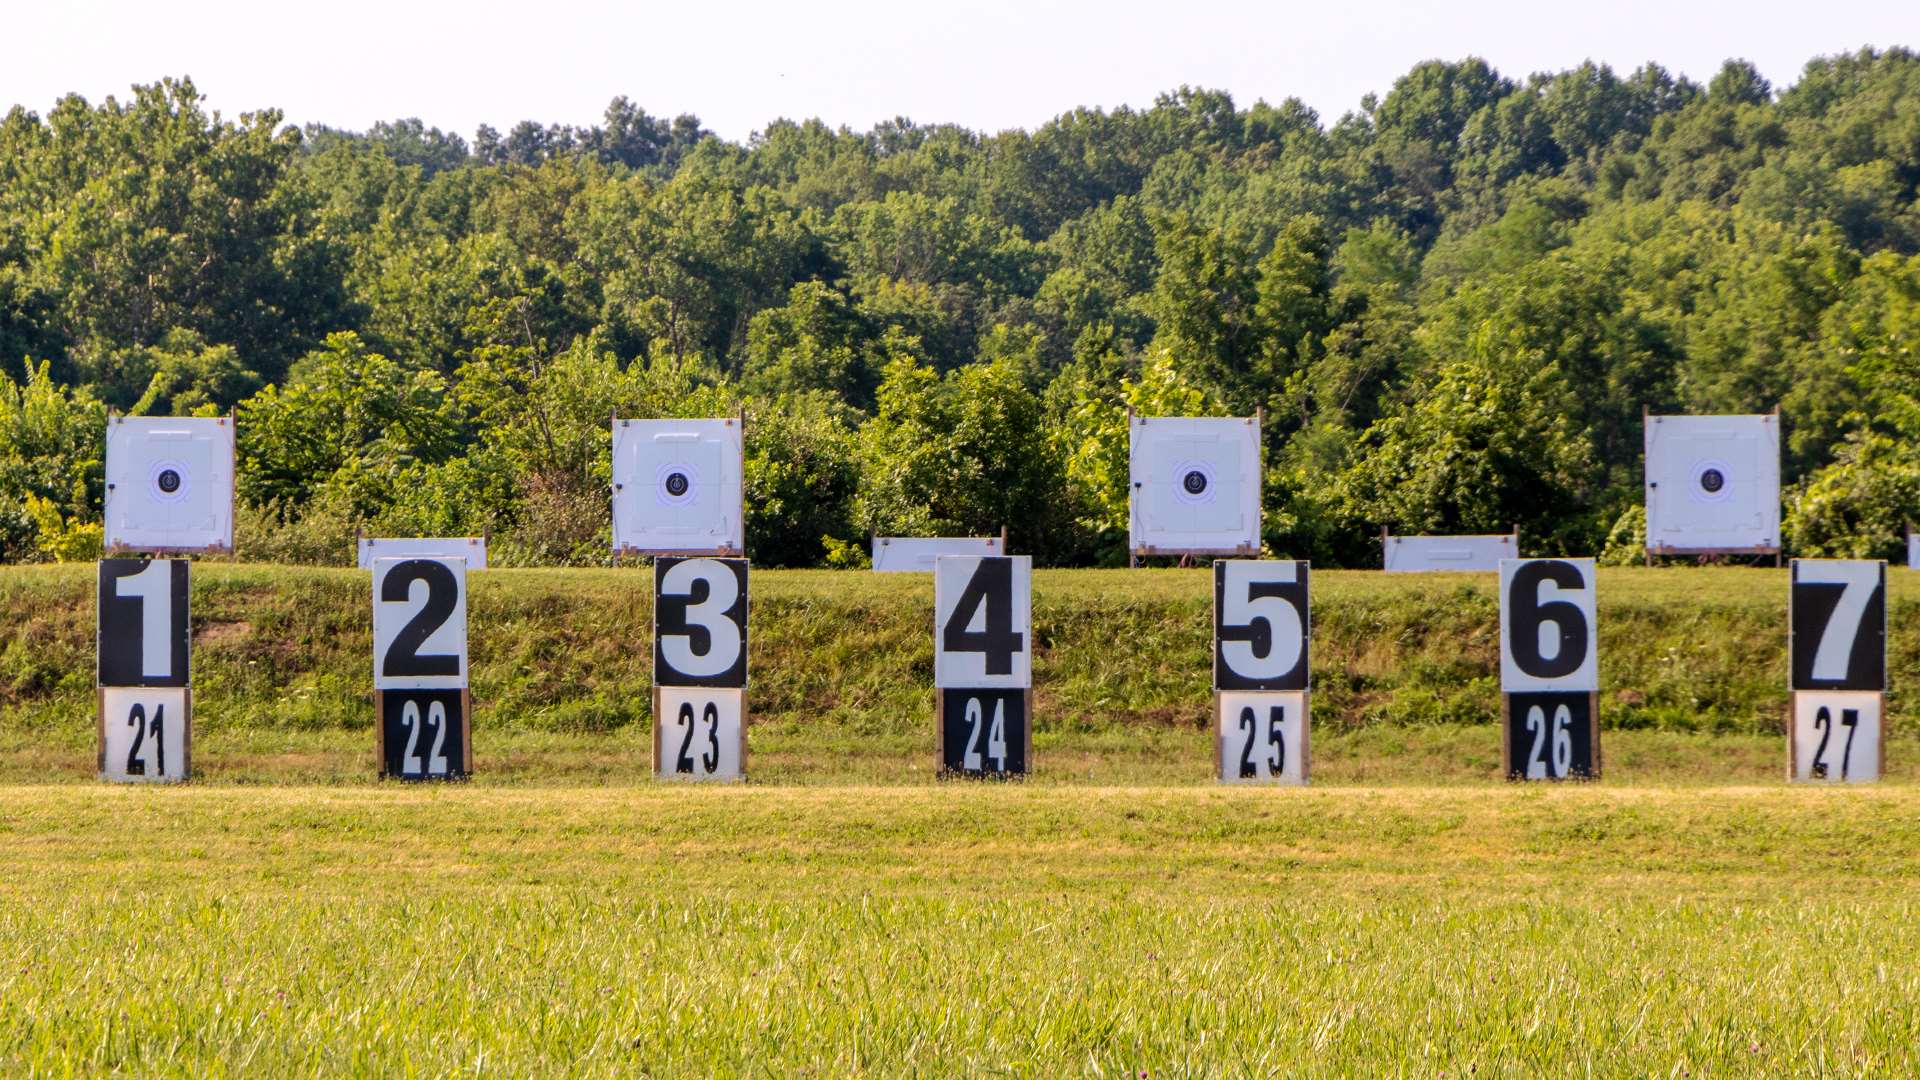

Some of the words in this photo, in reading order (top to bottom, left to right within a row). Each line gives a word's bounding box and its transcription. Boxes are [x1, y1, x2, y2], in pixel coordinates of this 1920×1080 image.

[116, 560, 171, 677] 1
[381, 560, 459, 676] 2
[660, 559, 742, 677] 3
[943, 557, 1023, 676] 4
[1222, 561, 1302, 680] 5
[1509, 561, 1588, 679] 6
[1797, 561, 1880, 680] 7
[126, 702, 165, 777] 21
[402, 699, 448, 776] 22
[676, 701, 720, 775] 23
[963, 697, 1007, 774] 24
[1239, 705, 1286, 779] 25
[1526, 703, 1578, 781] 26
[1810, 705, 1859, 781] 27
